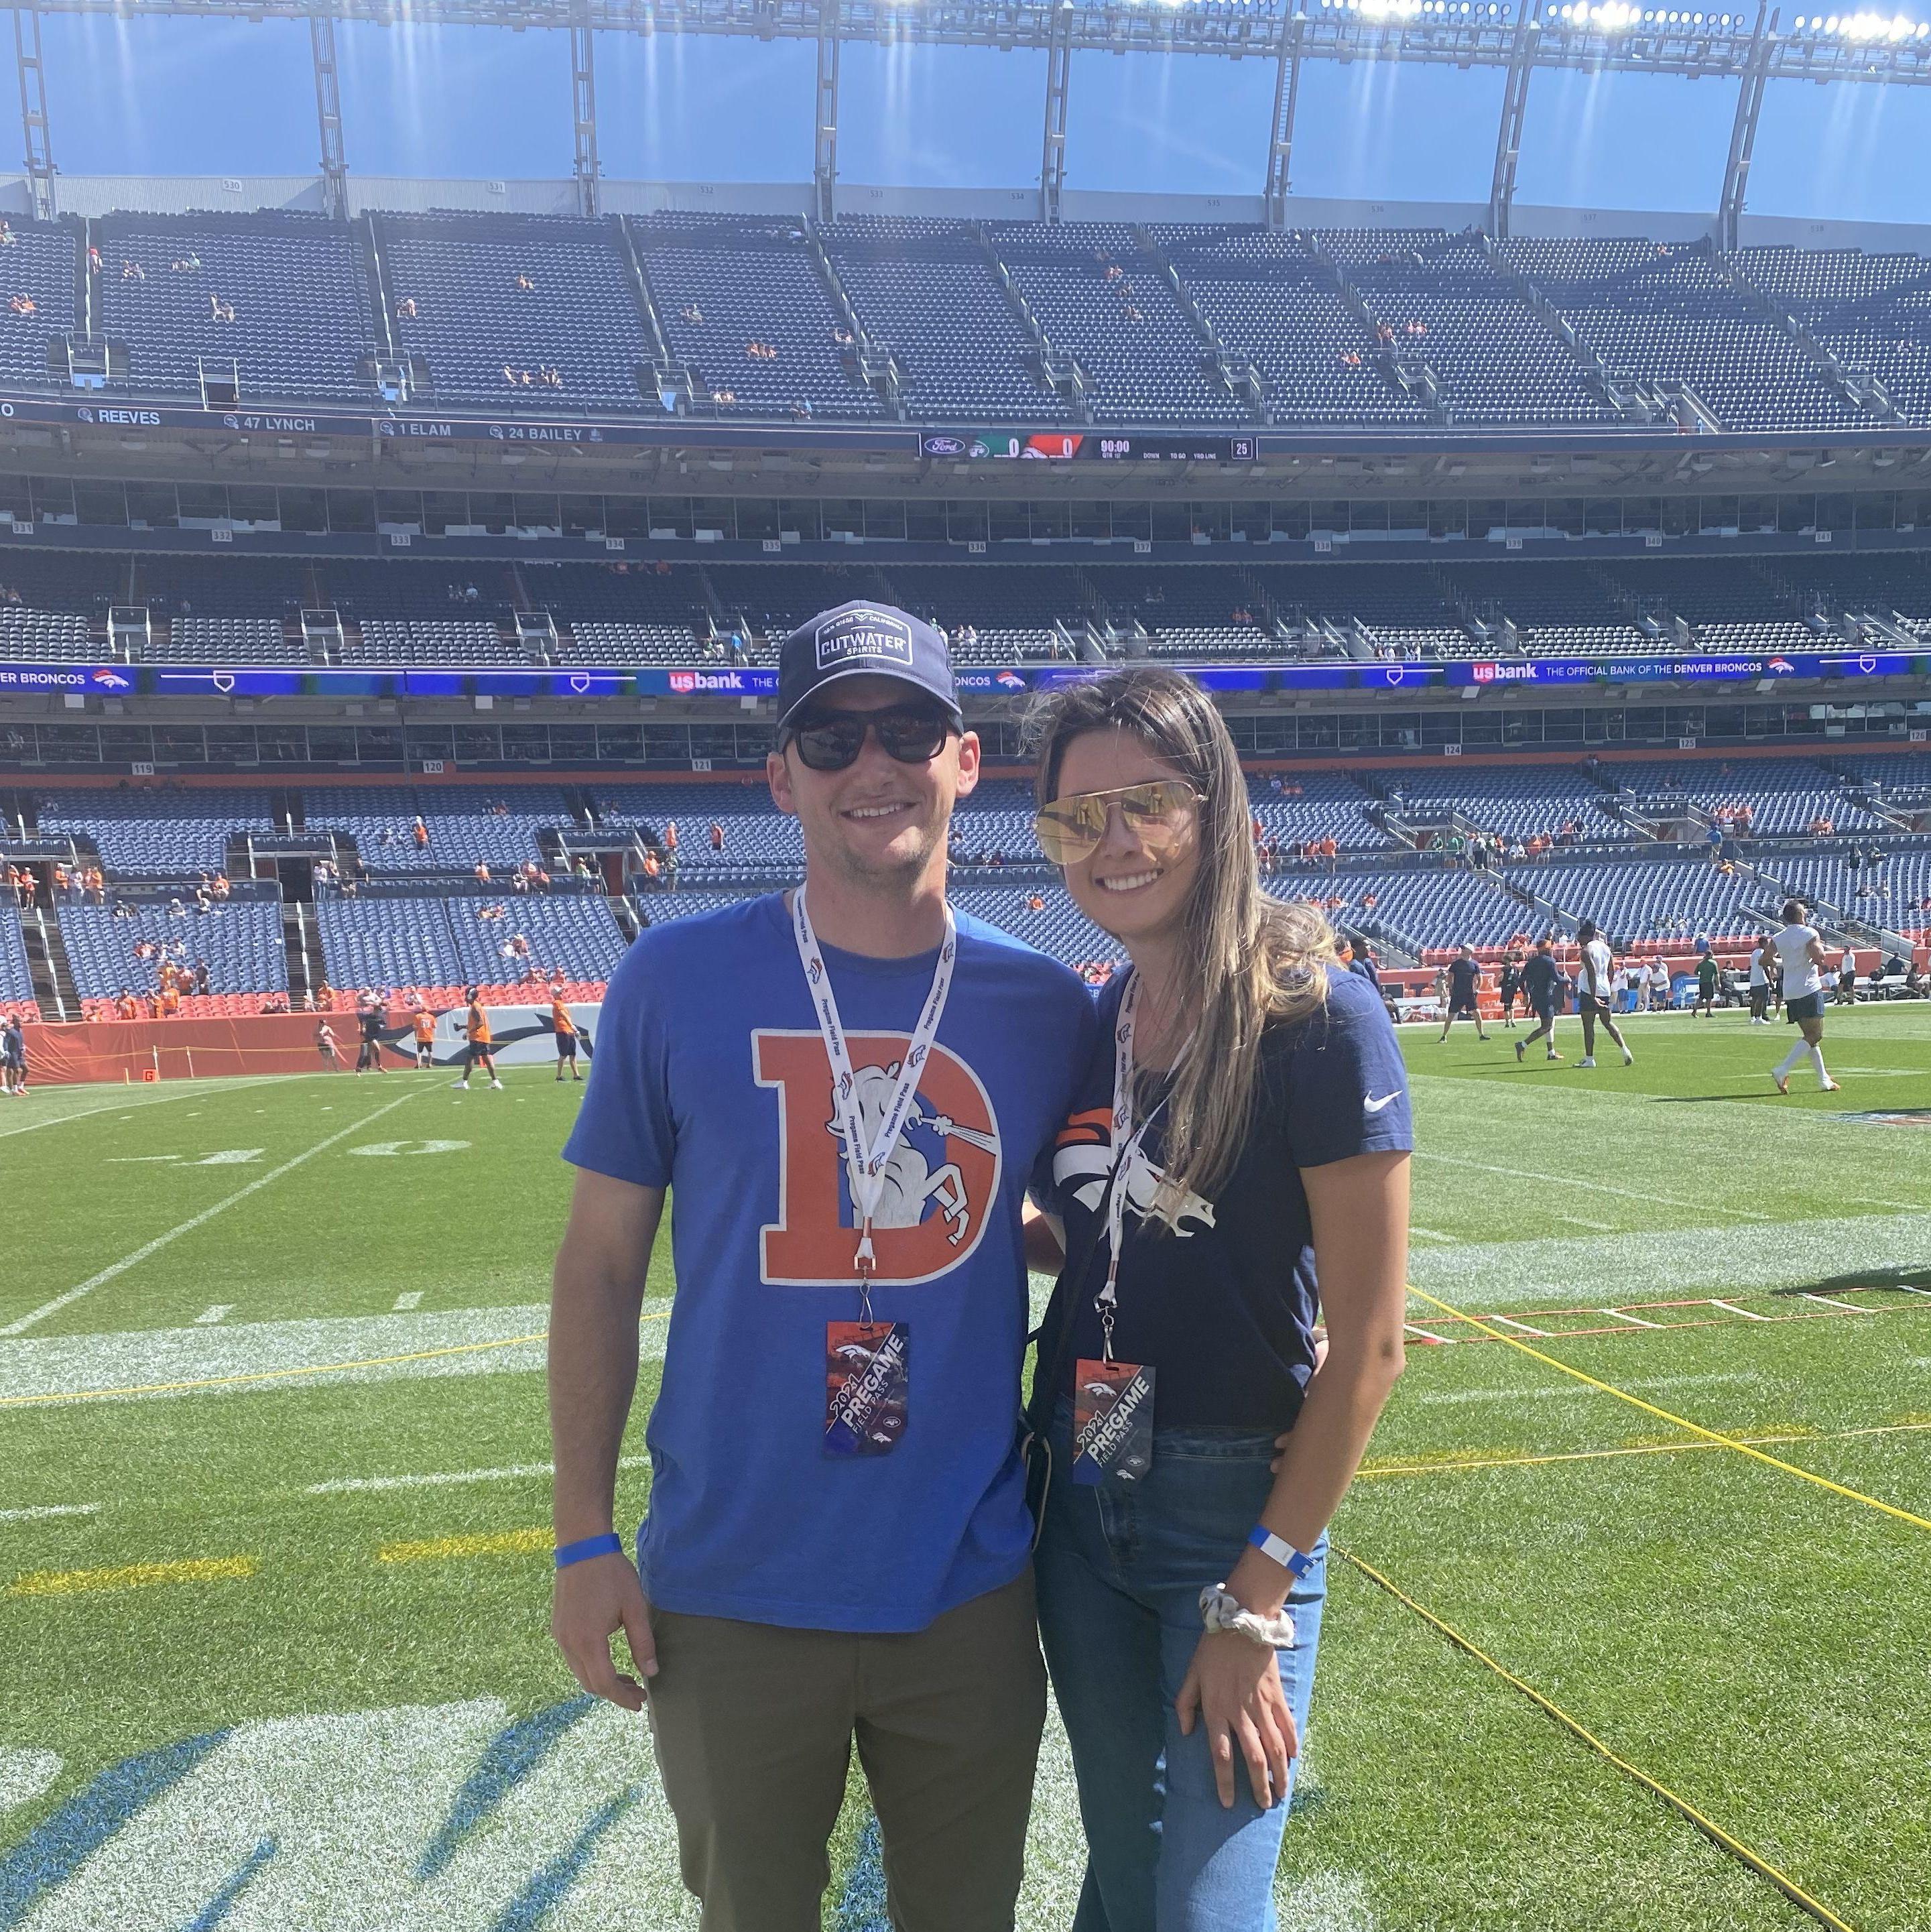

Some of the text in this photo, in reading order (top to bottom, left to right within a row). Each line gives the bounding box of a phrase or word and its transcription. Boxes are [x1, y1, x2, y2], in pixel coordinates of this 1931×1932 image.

[225, 181, 239, 190] 530
[489, 182, 503, 190] 531
[698, 186, 713, 194] 532
[98, 410, 160, 425] REEVES
[243, 417, 315, 432] 47 LYNCH
[400, 424, 451, 436] 1 ELAM
[509, 428, 582, 440] 24 BAILEY
[932, 440, 957, 451] Ford
[1009, 438, 1019, 457] 0
[1062, 438, 1072, 457] 0
[1237, 443, 1247, 455] 25
[820, 631, 907, 656] CUTWATER
[847, 646, 883, 655] SPIRITS
[1546, 667, 1564, 676] THE
[1566, 666, 1608, 676] OFFICIAL
[1610, 666, 1635, 675] BANK
[1638, 666, 1652, 674] OF
[1654, 664, 1672, 674] THE
[1674, 664, 1713, 673] DENVER
[1715, 662, 1762, 672] BRONCOS
[20, 673, 86, 684] BRONCOS
[751, 678, 773, 687] THE
[1681, 739, 1694, 747] 125
[1911, 733, 1925, 741] 126
[1446, 745, 1460, 754] 124
[135, 764, 151, 774] 119
[426, 763, 442, 772] 120
[694, 760, 709, 770] 121
[145, 1071, 153, 1081] G
[884, 1083, 910, 1138] Pregame Field Pass
[849, 1115, 858, 1142] Pregame
[854, 1144, 863, 1159] Field
[751, 1028, 1003, 1286] D
[840, 1333, 905, 1429] PREGAME
[829, 1373, 861, 1412] 2021
[851, 1380, 889, 1435] FIELD PASS
[1086, 1376, 1150, 1462] PREGAME
[1076, 1409, 1106, 1445] 2021
[1097, 1420, 1133, 1469] FIELD PASS
